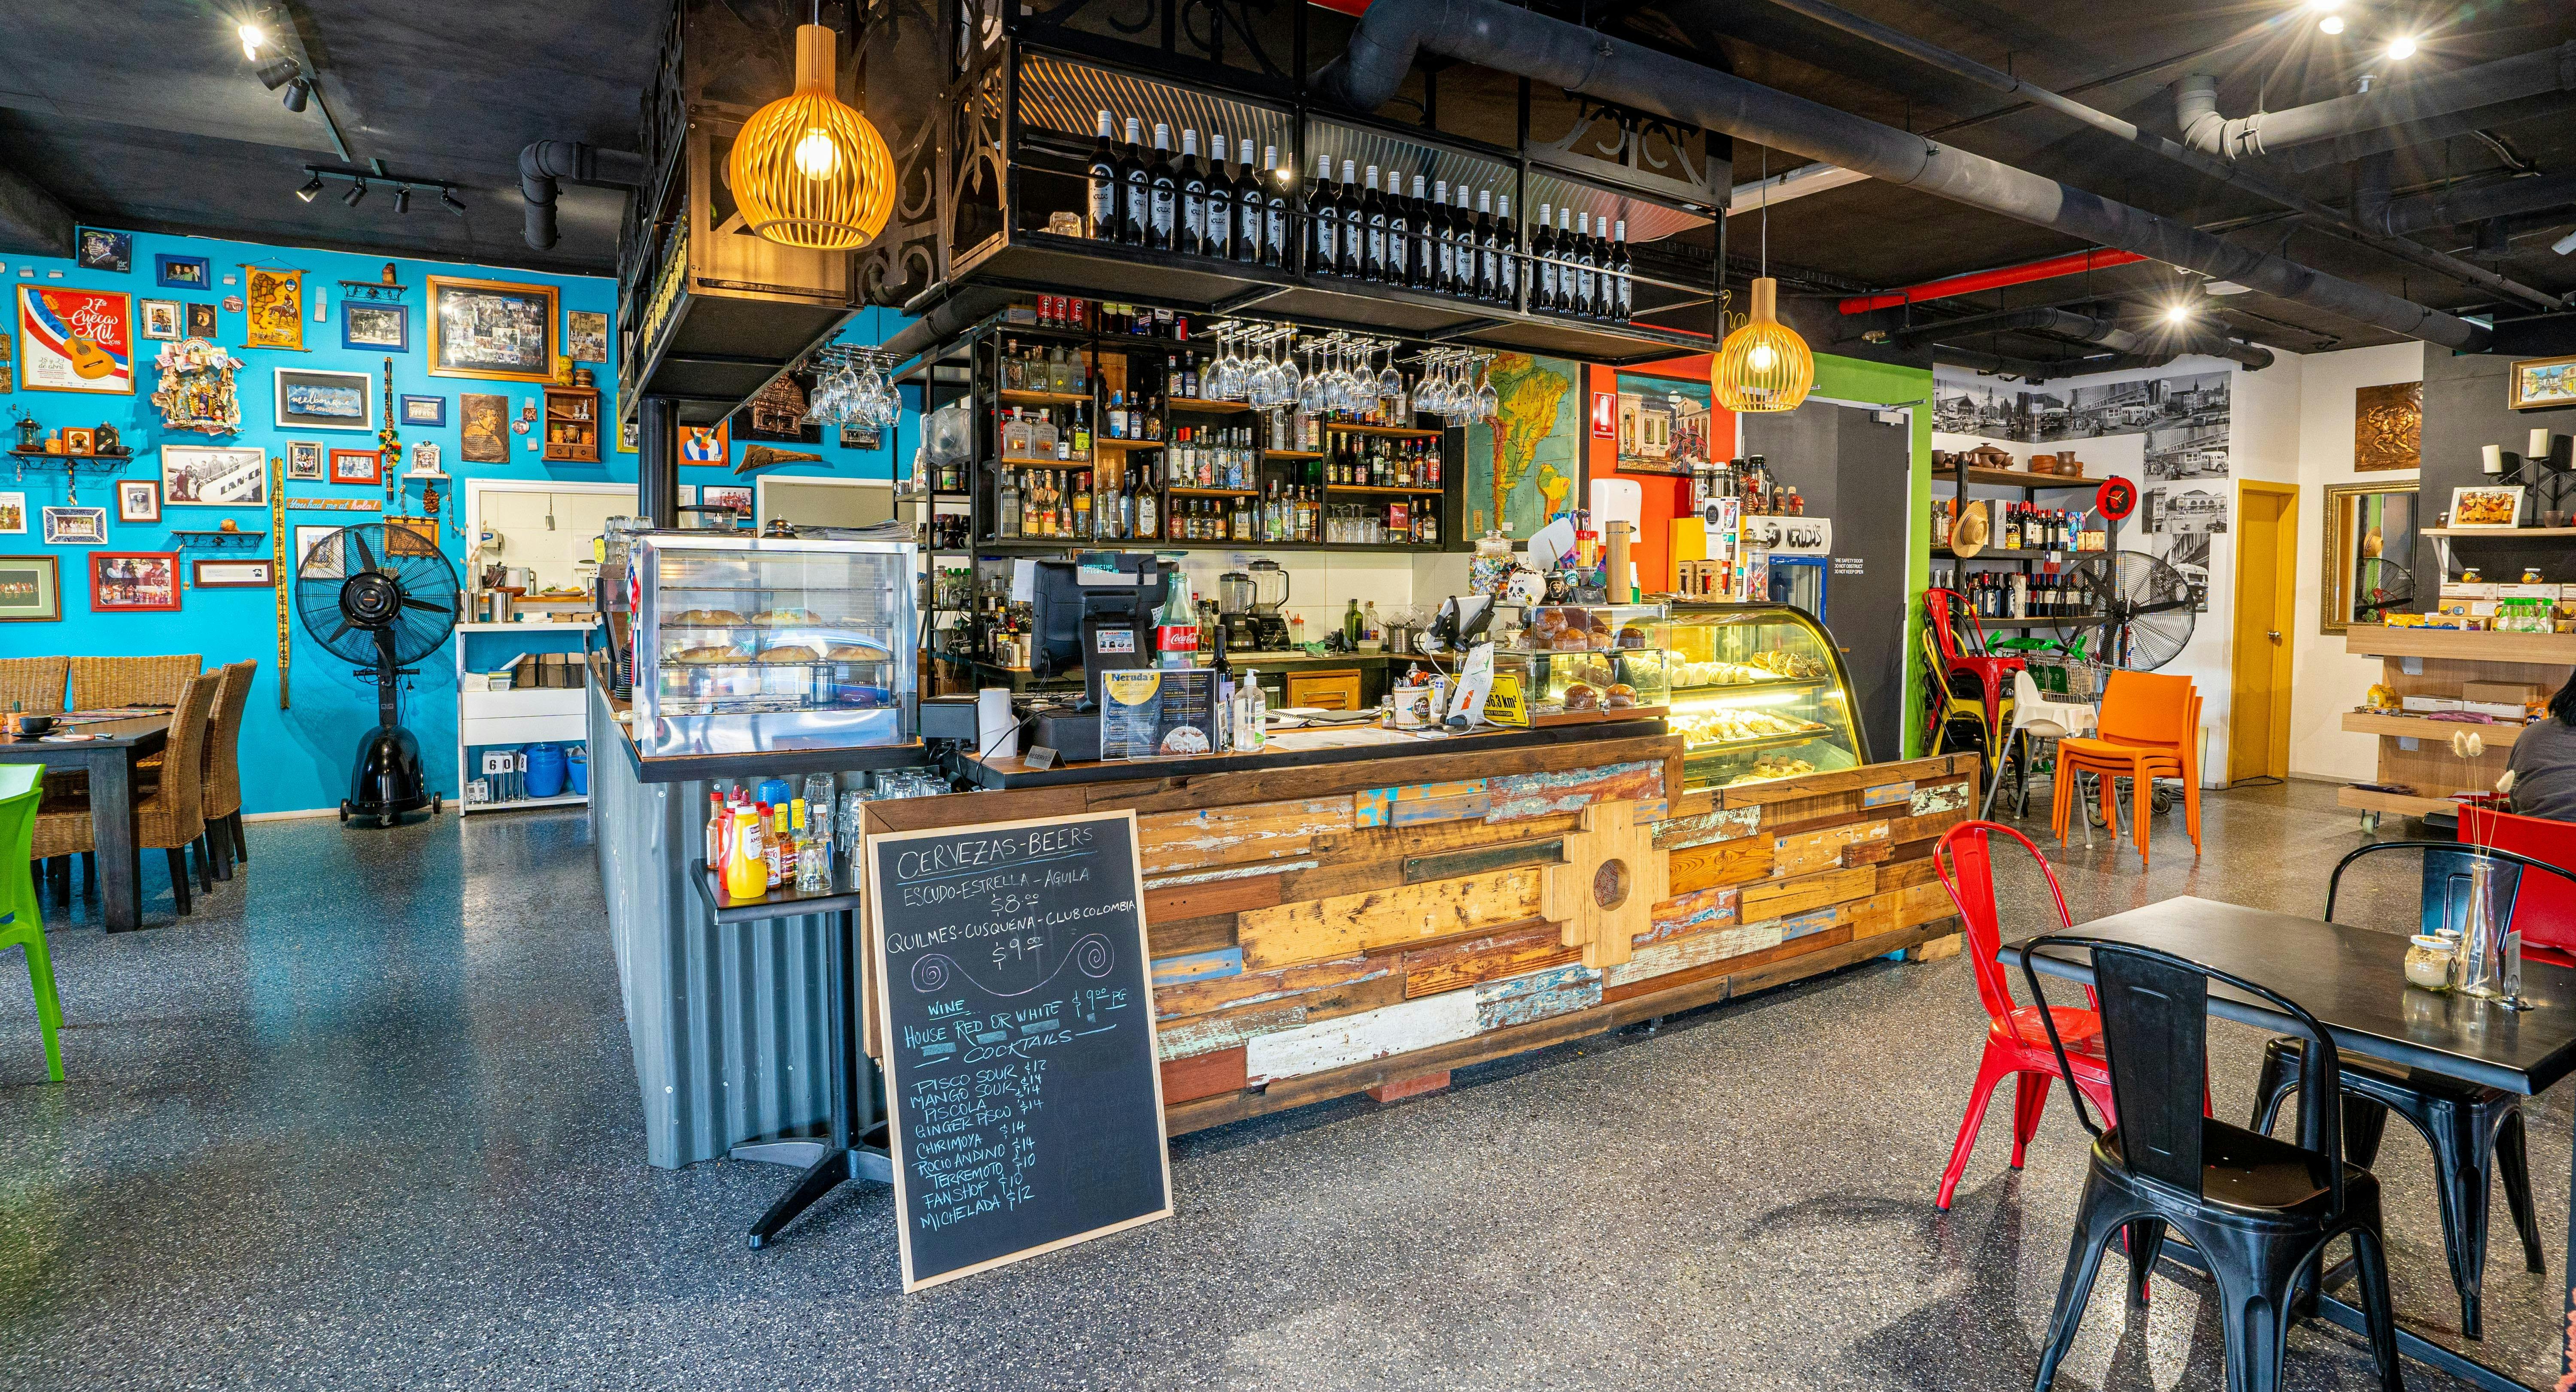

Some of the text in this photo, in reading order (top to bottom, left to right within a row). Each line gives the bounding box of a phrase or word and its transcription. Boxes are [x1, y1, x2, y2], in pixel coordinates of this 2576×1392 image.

[55, 310, 118, 326] Cuecas
[74, 321, 114, 345] Mil
[1276, 432, 1284, 442] 40
[1298, 434, 1307, 443] 35
[289, 498, 306, 509] You
[307, 499, 325, 509] had
[338, 501, 350, 510] at
[350, 500, 378, 510] hola!
[1786, 524, 1822, 548] NERUDA'S
[1170, 633, 1197, 644] Coca-Cola
[1111, 673, 1154, 681] Neruda's
[1485, 694, 1501, 709] 96,3
[489, 759, 496, 770] 6
[504, 758, 510, 769] 0
[520, 758, 524, 768] 8
[1029, 753, 1051, 762] RESERVED
[1044, 867, 1089, 889] AGUILA
[1082, 900, 1136, 919] COLOMBIA
[927, 999, 965, 1016] WINE
[904, 1026, 947, 1049] HOUSE
[954, 1018, 983, 1046] RED
[991, 1013, 1012, 1029] OR
[1015, 1001, 1064, 1023] WHITE
[963, 1030, 1073, 1063] COCKTAILS
[911, 1060, 1047, 1095] PISCO SOUR $12
[910, 1073, 1042, 1109] MANGO SOUR $14
[925, 1085, 1040, 1123] PISCOLA $14
[915, 1099, 1044, 1138] GINGER PISCO $14
[917, 1121, 1026, 1159] CHIRIMOYA $14
[955, 1143, 1005, 1168] ANDINO
[1012, 1137, 1035, 1158] $14
[927, 1154, 1036, 1191] TERREMOTO $10
[998, 1174, 1023, 1196] $10
[920, 1186, 1035, 1231] MICHELADA $12
